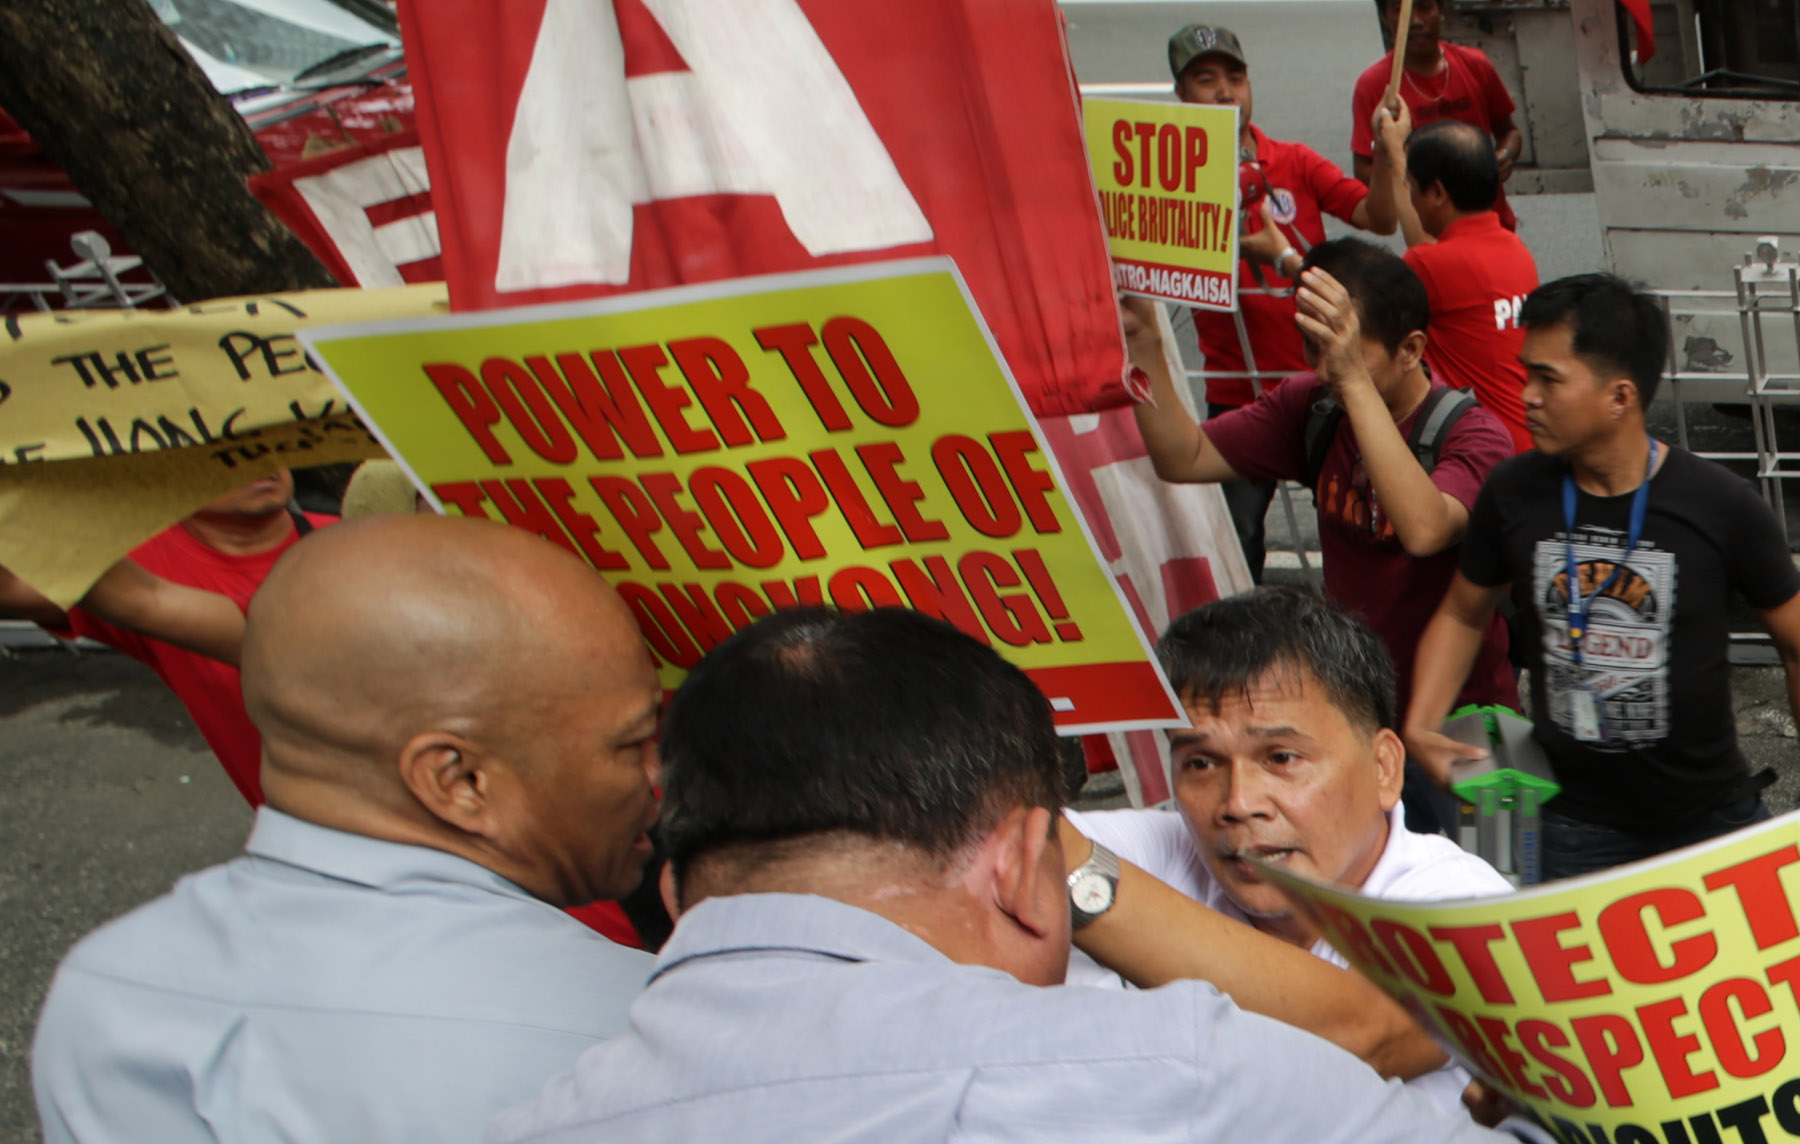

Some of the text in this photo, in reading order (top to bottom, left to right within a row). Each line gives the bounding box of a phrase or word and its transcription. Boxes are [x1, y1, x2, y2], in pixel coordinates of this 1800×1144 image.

[1112, 118, 1209, 194] STOP
[1138, 193, 1233, 254] BRUTALITY!
[51, 344, 179, 390] THE
[422, 336, 786, 466] POWER
[752, 316, 920, 433] TO
[588, 440, 952, 572] PEOPLE
[930, 428, 1062, 540] OF
